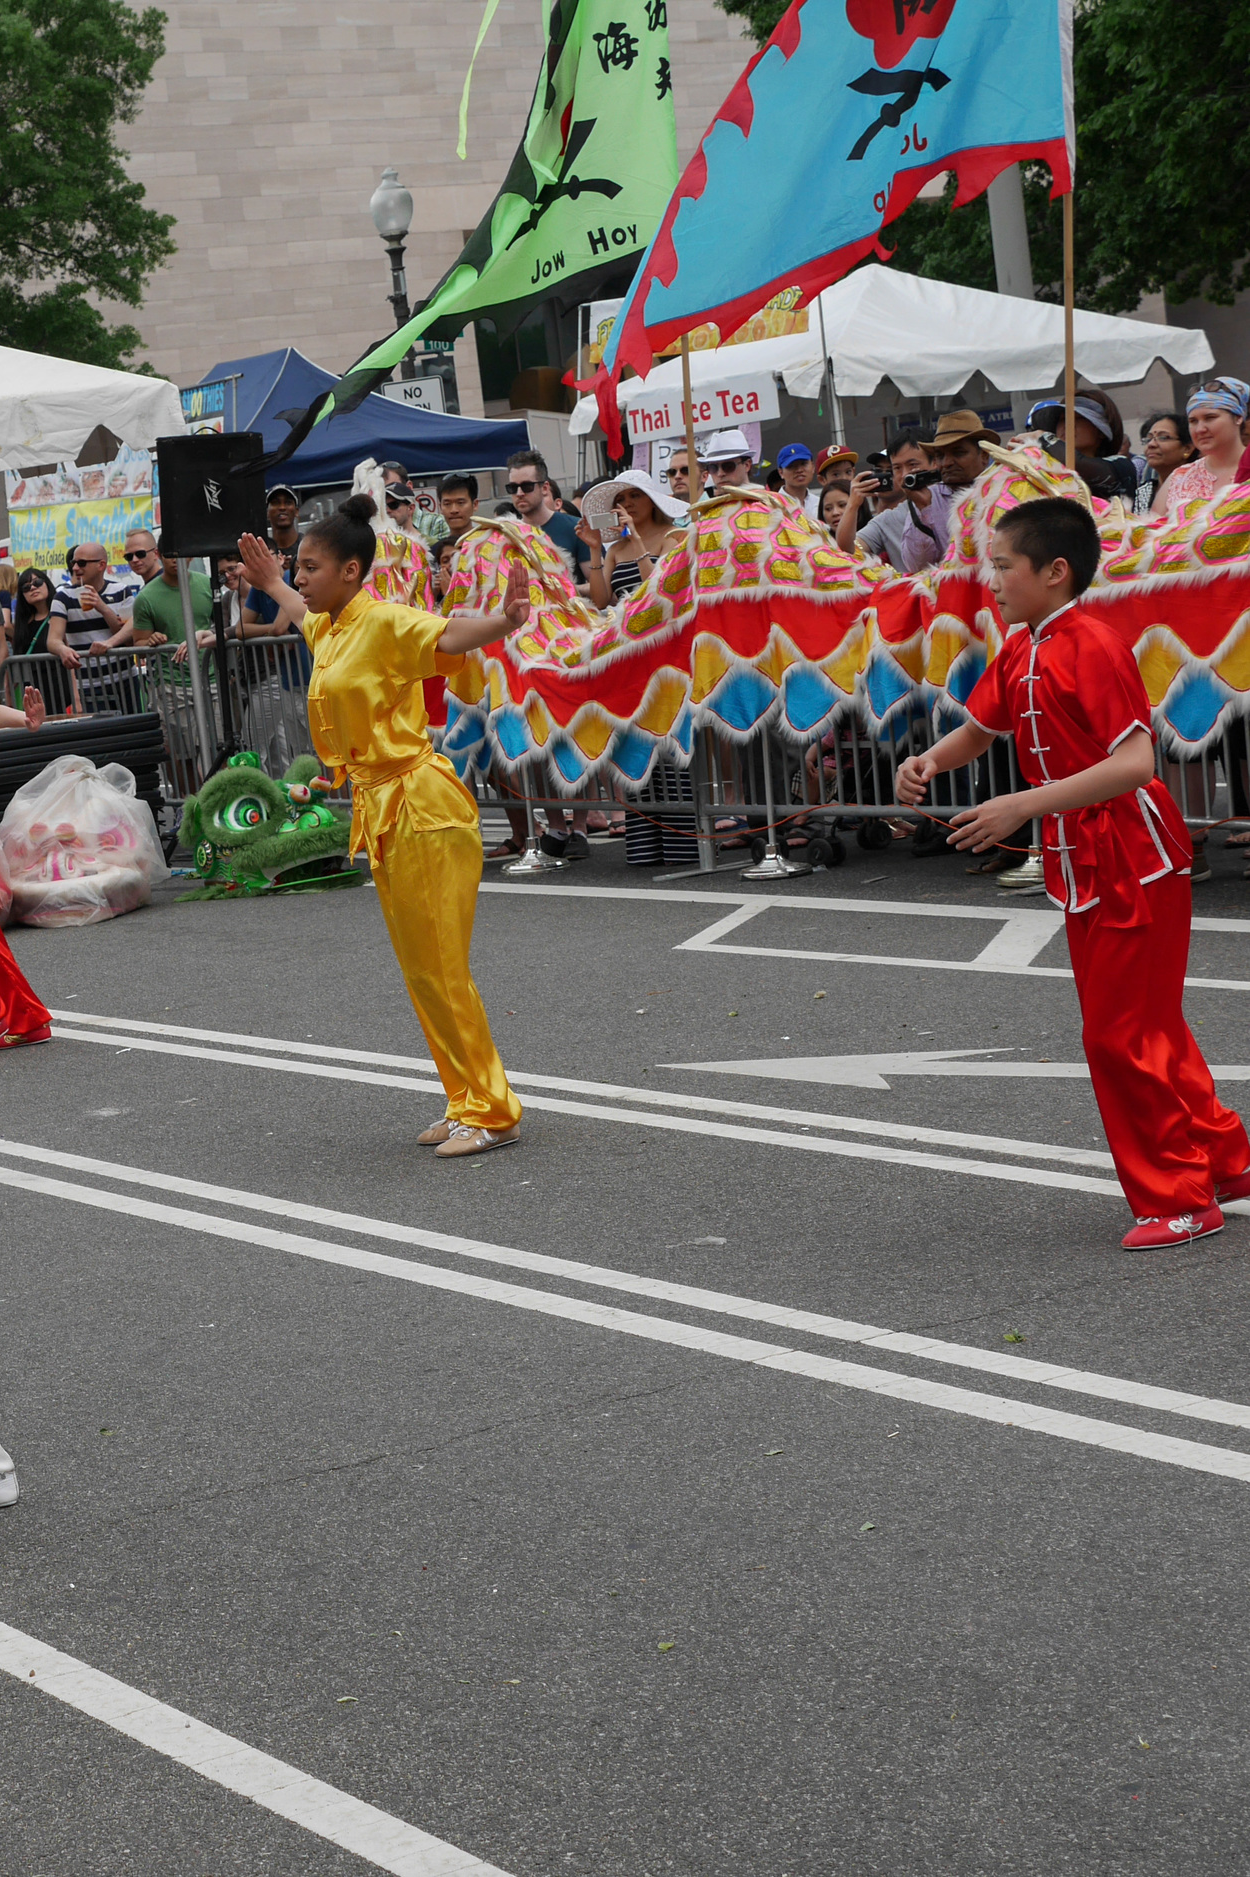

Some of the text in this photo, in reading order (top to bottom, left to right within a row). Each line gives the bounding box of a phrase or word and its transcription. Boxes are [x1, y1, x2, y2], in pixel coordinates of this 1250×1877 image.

[531, 224, 638, 284] Jow Hoy
[403, 386, 423, 400] NO
[628, 389, 760, 434] Thai Ice Tea
